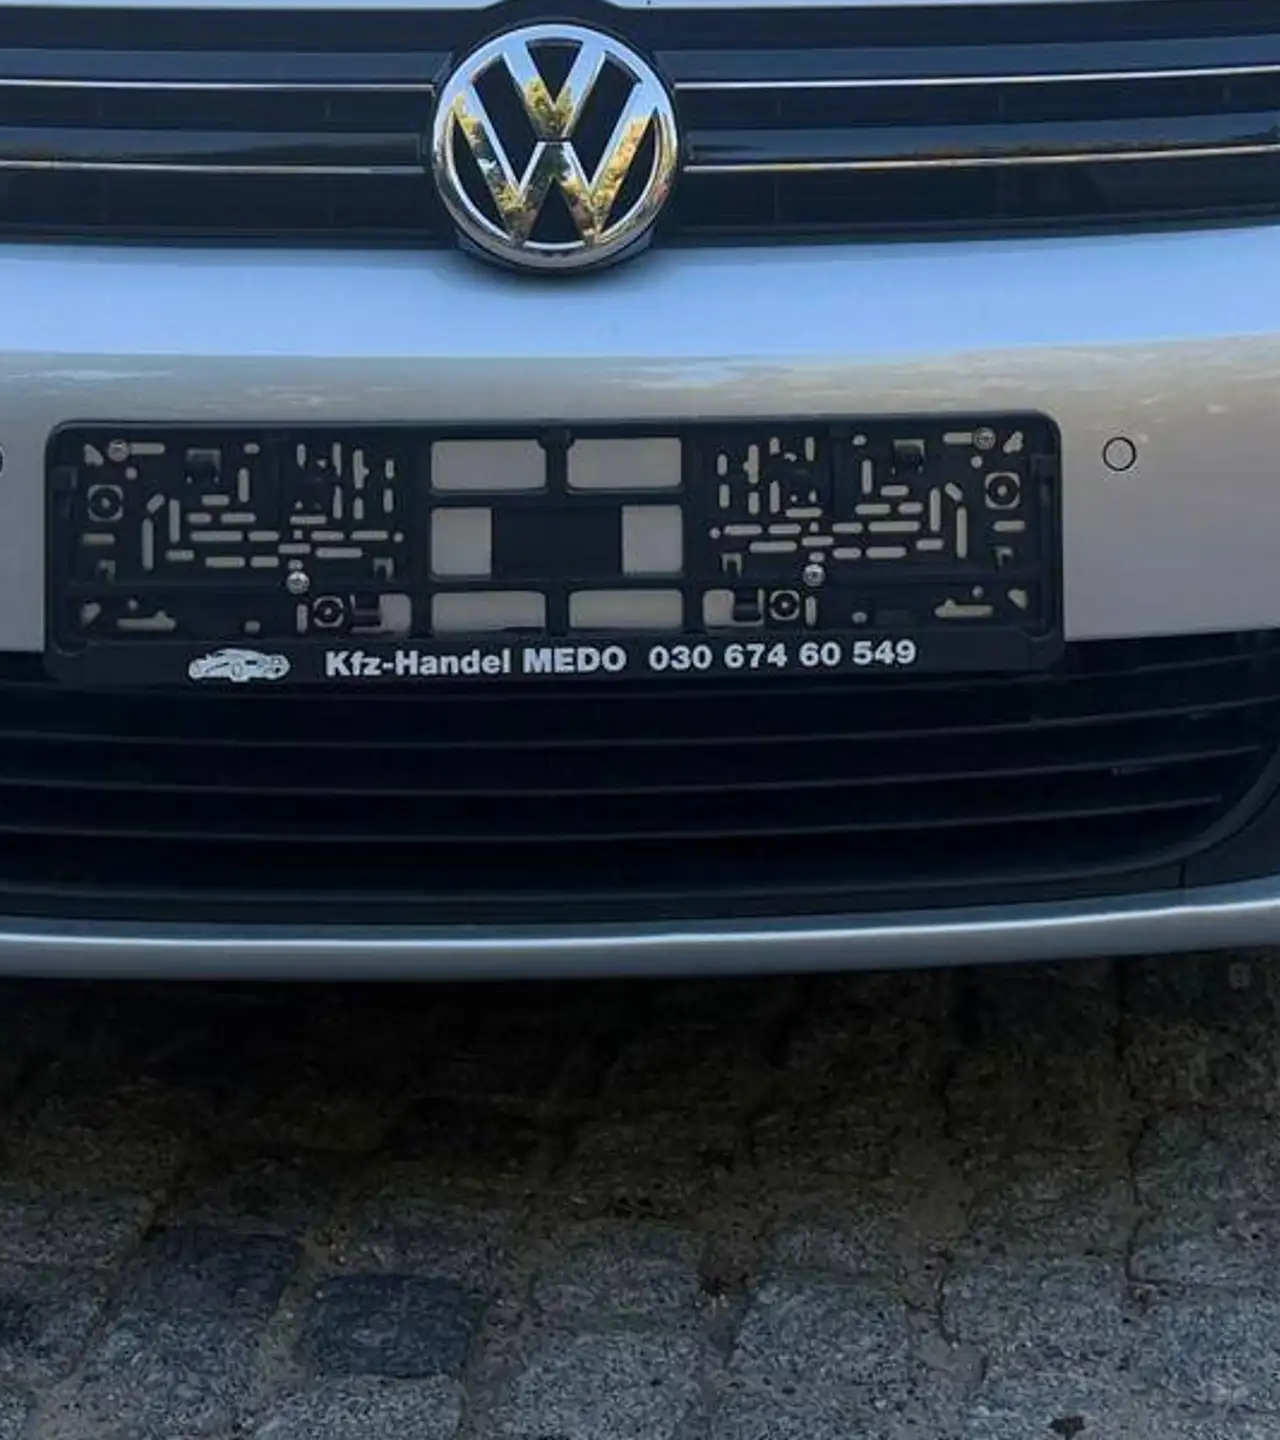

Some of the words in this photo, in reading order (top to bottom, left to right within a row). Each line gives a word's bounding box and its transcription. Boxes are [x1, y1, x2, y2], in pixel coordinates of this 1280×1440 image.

[440, 30, 670, 258] VW
[326, 648, 510, 676] Kfz-Handel
[523, 645, 627, 673] MEDO
[649, 645, 713, 671] 030
[724, 643, 788, 668] 674
[799, 641, 841, 666] 60
[852, 639, 916, 665] 549
